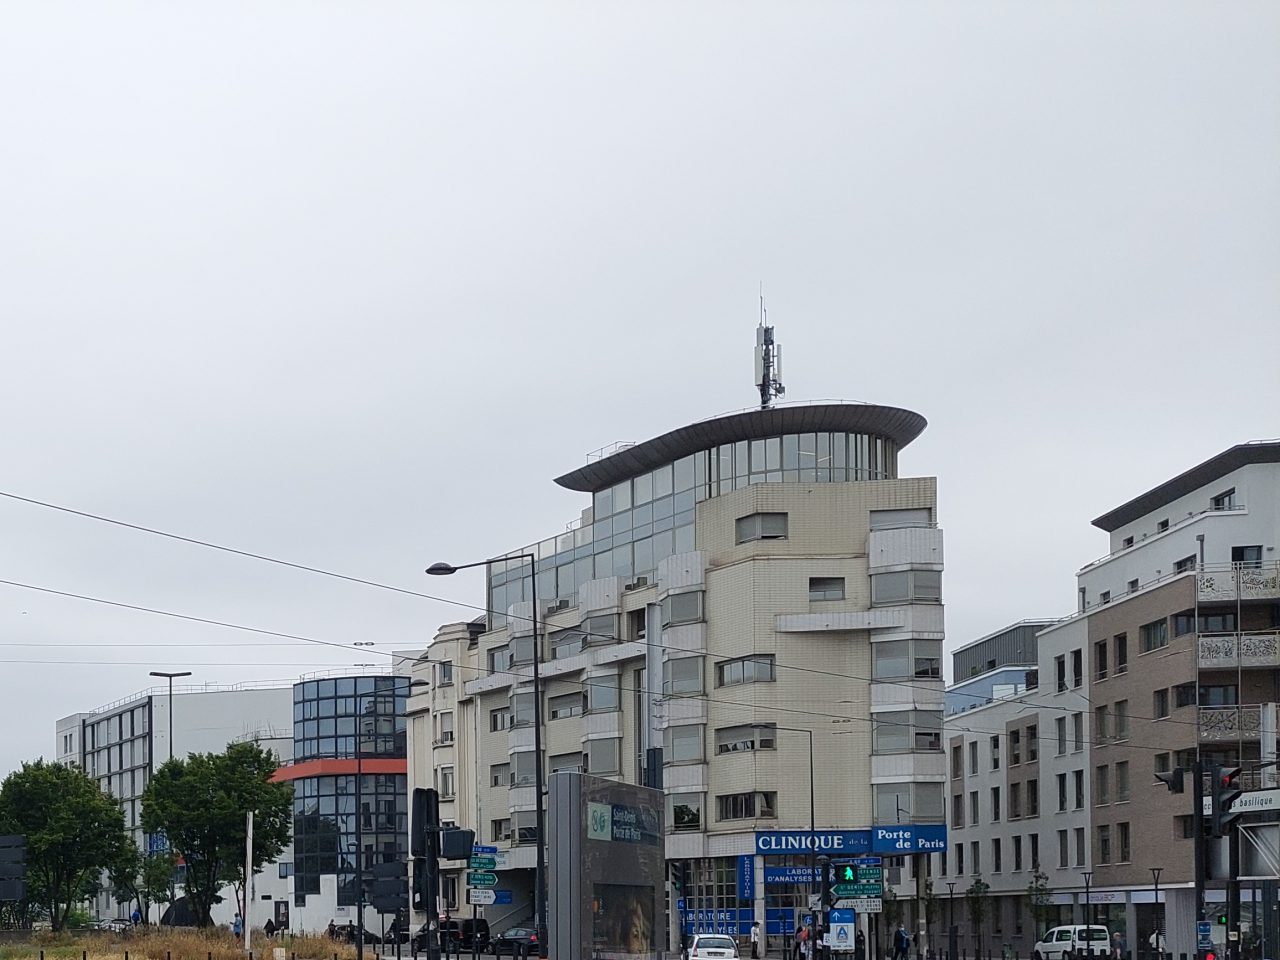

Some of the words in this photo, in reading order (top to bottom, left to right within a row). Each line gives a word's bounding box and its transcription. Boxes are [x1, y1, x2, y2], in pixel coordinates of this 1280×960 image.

[1240, 797, 1273, 808] basilique
[878, 830, 911, 839] Porte
[758, 835, 844, 850] CLINIQUE
[896, 839, 911, 849] de
[918, 838, 945, 848] Paris
